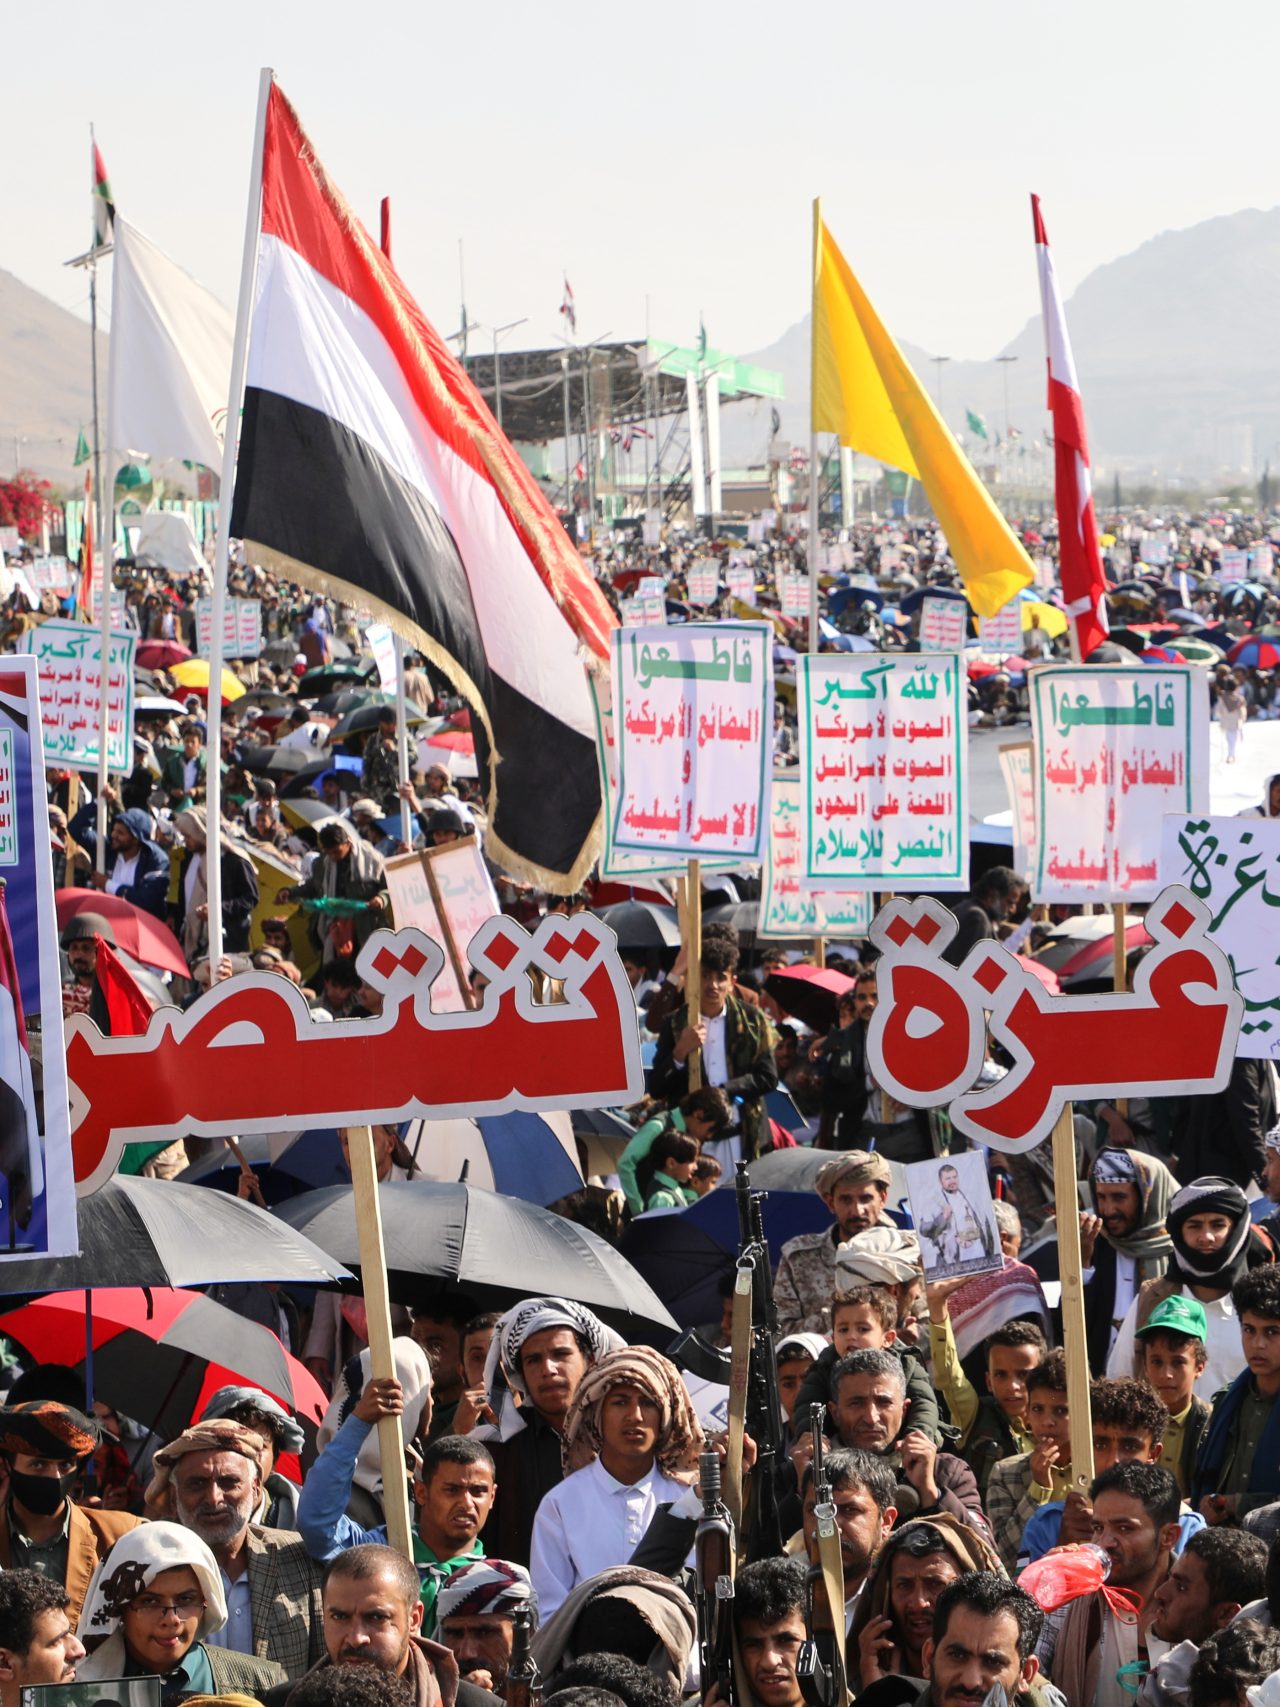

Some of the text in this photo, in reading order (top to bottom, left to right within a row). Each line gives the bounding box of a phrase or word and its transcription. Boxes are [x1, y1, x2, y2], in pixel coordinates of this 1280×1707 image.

[39, 665, 126, 690] الوت لأمريك
[92, 646, 126, 664] اله
[632, 632, 753, 690] قاطعوا
[814, 657, 952, 711] الله أكبر
[625, 694, 692, 744] الأمريكية
[697, 701, 759, 749] البضائع
[814, 709, 952, 744] الموت لأمريكا
[1050, 681, 1176, 738] قاطعوا
[682, 749, 692, 785] و
[814, 753, 952, 786] الموت لإسرائيل
[1045, 744, 1184, 794] البضائع الأمريكية
[624, 794, 756, 846] الإسرائيلية
[814, 791, 952, 822] اللعنة على اليهود
[1106, 797, 1116, 833] و
[814, 828, 884, 869] للإسلام
[889, 824, 952, 868] النصر
[1046, 845, 1158, 891] سرائيلية
[1178, 819, 1268, 933] غزة
[881, 900, 1229, 1140] غزة
[66, 927, 629, 1184] تنتصر
